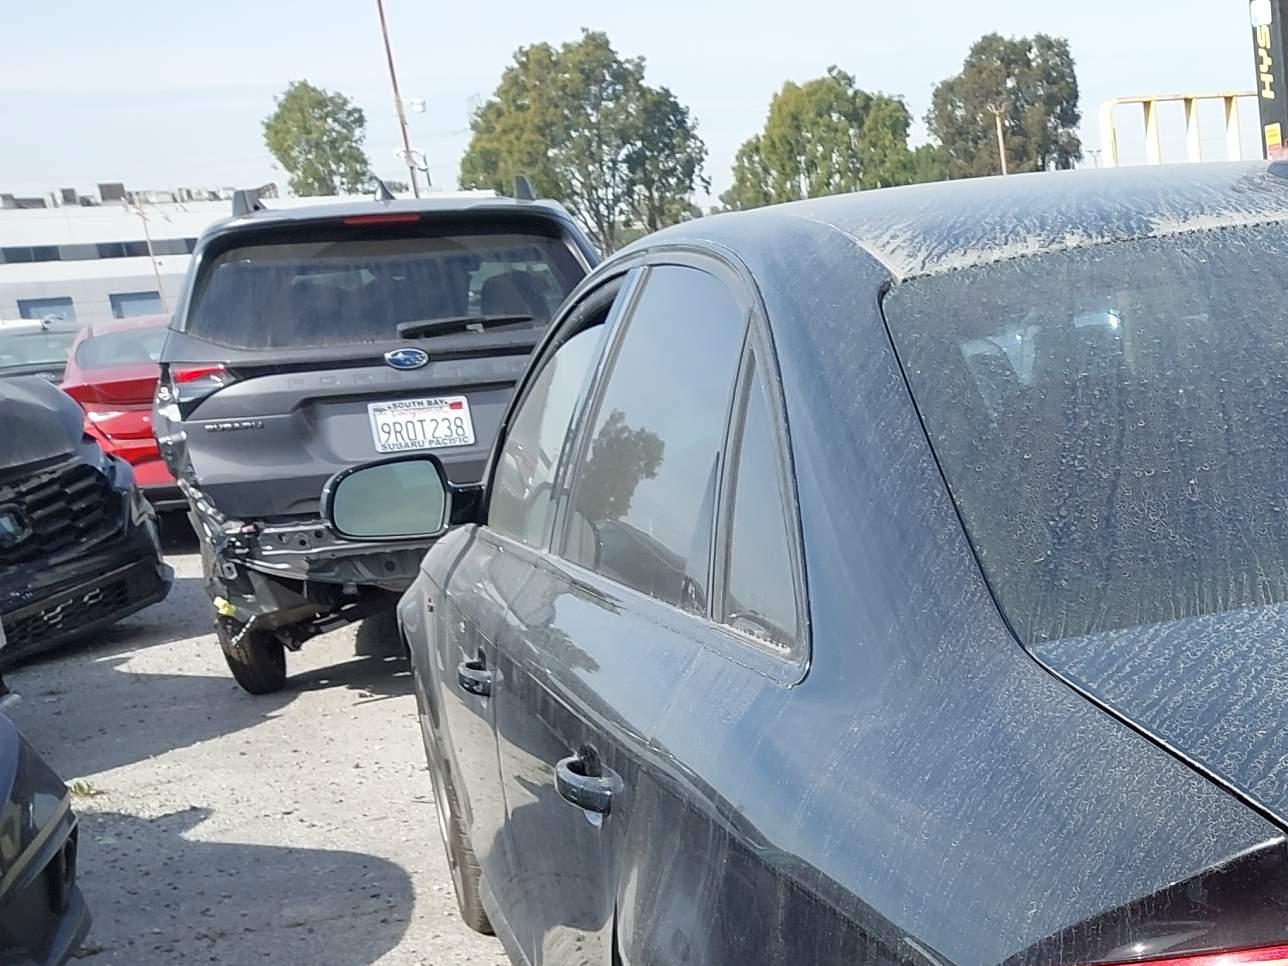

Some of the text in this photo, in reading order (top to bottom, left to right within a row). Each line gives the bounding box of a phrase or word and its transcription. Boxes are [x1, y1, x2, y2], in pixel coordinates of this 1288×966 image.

[391, 399, 445, 409] SOUTH BAY
[381, 436, 469, 451] SUBARU PACIFIC
